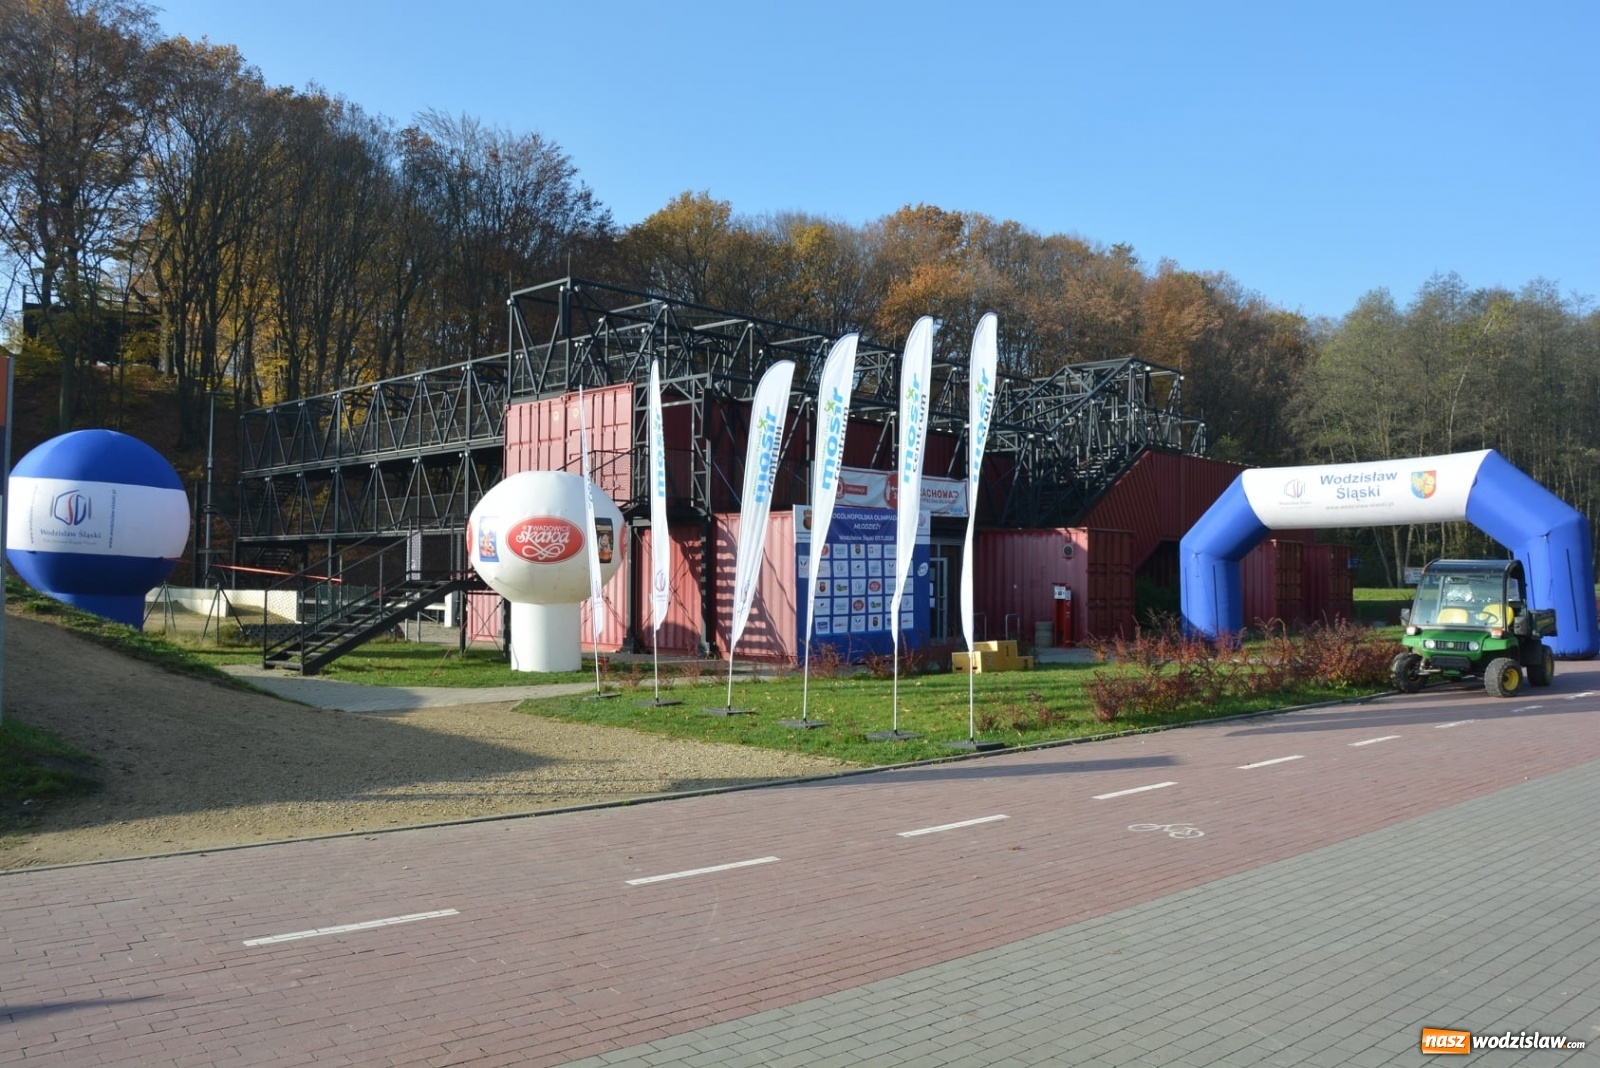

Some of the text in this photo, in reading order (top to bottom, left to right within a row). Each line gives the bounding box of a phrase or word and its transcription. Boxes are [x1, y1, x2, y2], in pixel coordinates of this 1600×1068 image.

[754, 405, 777, 503] mosir
[821, 387, 843, 490] mosir
[903, 372, 920, 484] mosir
[912, 394, 926, 473] centrum
[921, 489, 959, 499] ACHOWAJ
[1320, 471, 1397, 486] Wodzisław
[1336, 485, 1380, 502] Śląski
